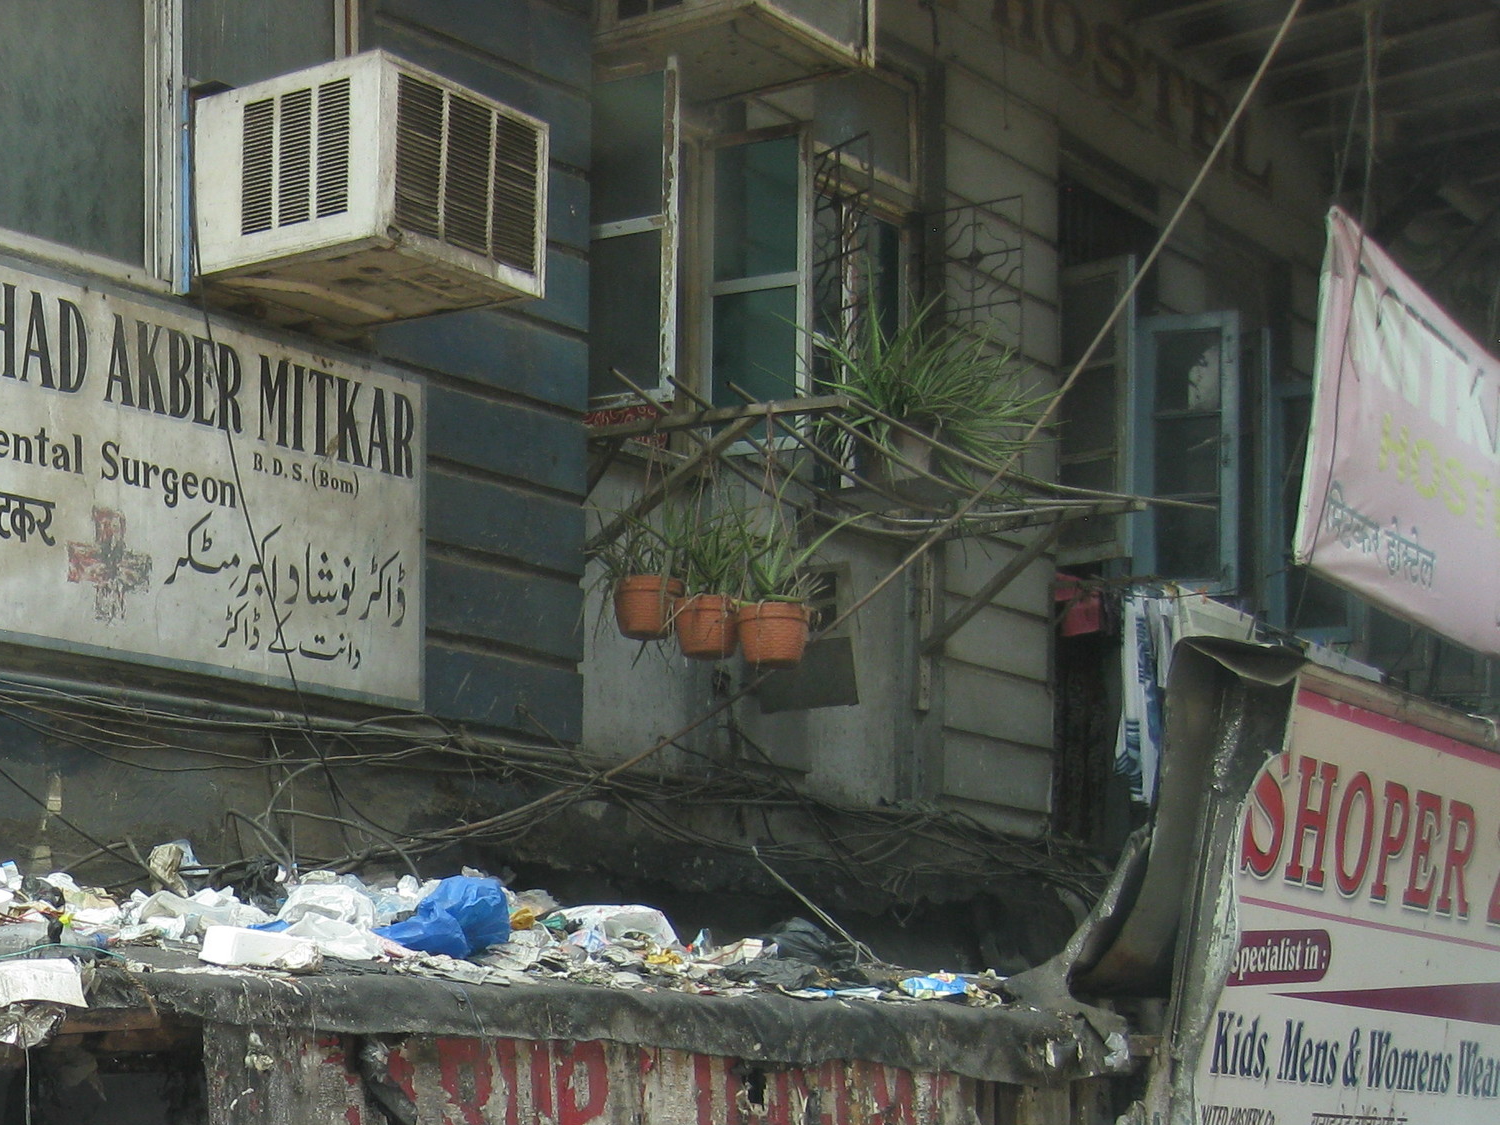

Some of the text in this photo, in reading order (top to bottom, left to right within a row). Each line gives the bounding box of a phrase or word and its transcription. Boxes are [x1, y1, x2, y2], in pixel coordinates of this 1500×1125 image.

[103, 312, 243, 434] AKBER
[257, 353, 414, 479] MITKAR
[100, 440, 237, 508] Surgeon
[1239, 752, 1476, 921] SHOPER
[1209, 1010, 1500, 1099] Kids, Mens & Womens Wear
